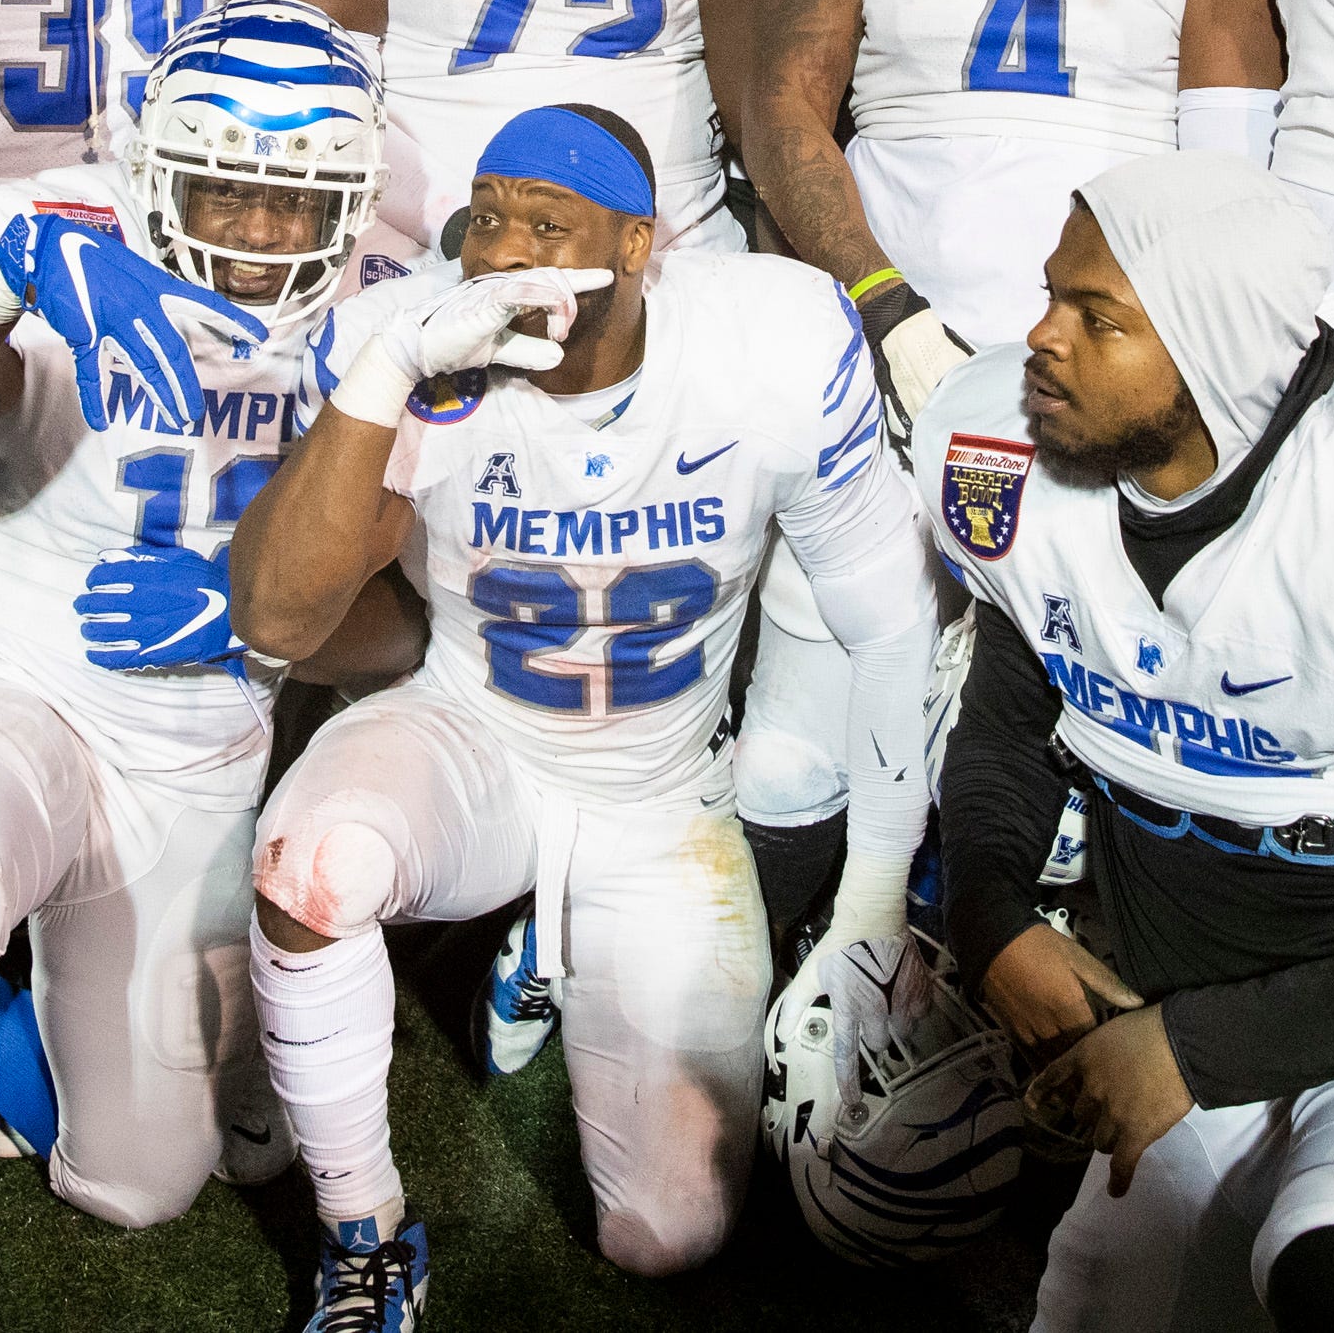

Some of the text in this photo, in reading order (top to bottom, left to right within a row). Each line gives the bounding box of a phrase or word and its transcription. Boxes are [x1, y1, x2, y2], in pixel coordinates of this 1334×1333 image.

[66, 209, 113, 223] AutoZone
[373, 262, 400, 278] TIGER
[972, 452, 1025, 471] AutoZone
[951, 466, 1017, 489] LIBERTY
[957, 483, 1002, 511] BOWL
[468, 496, 725, 557] MEMPHIS
[466, 556, 722, 717] 22
[1038, 651, 1299, 766] MEMPHIS
